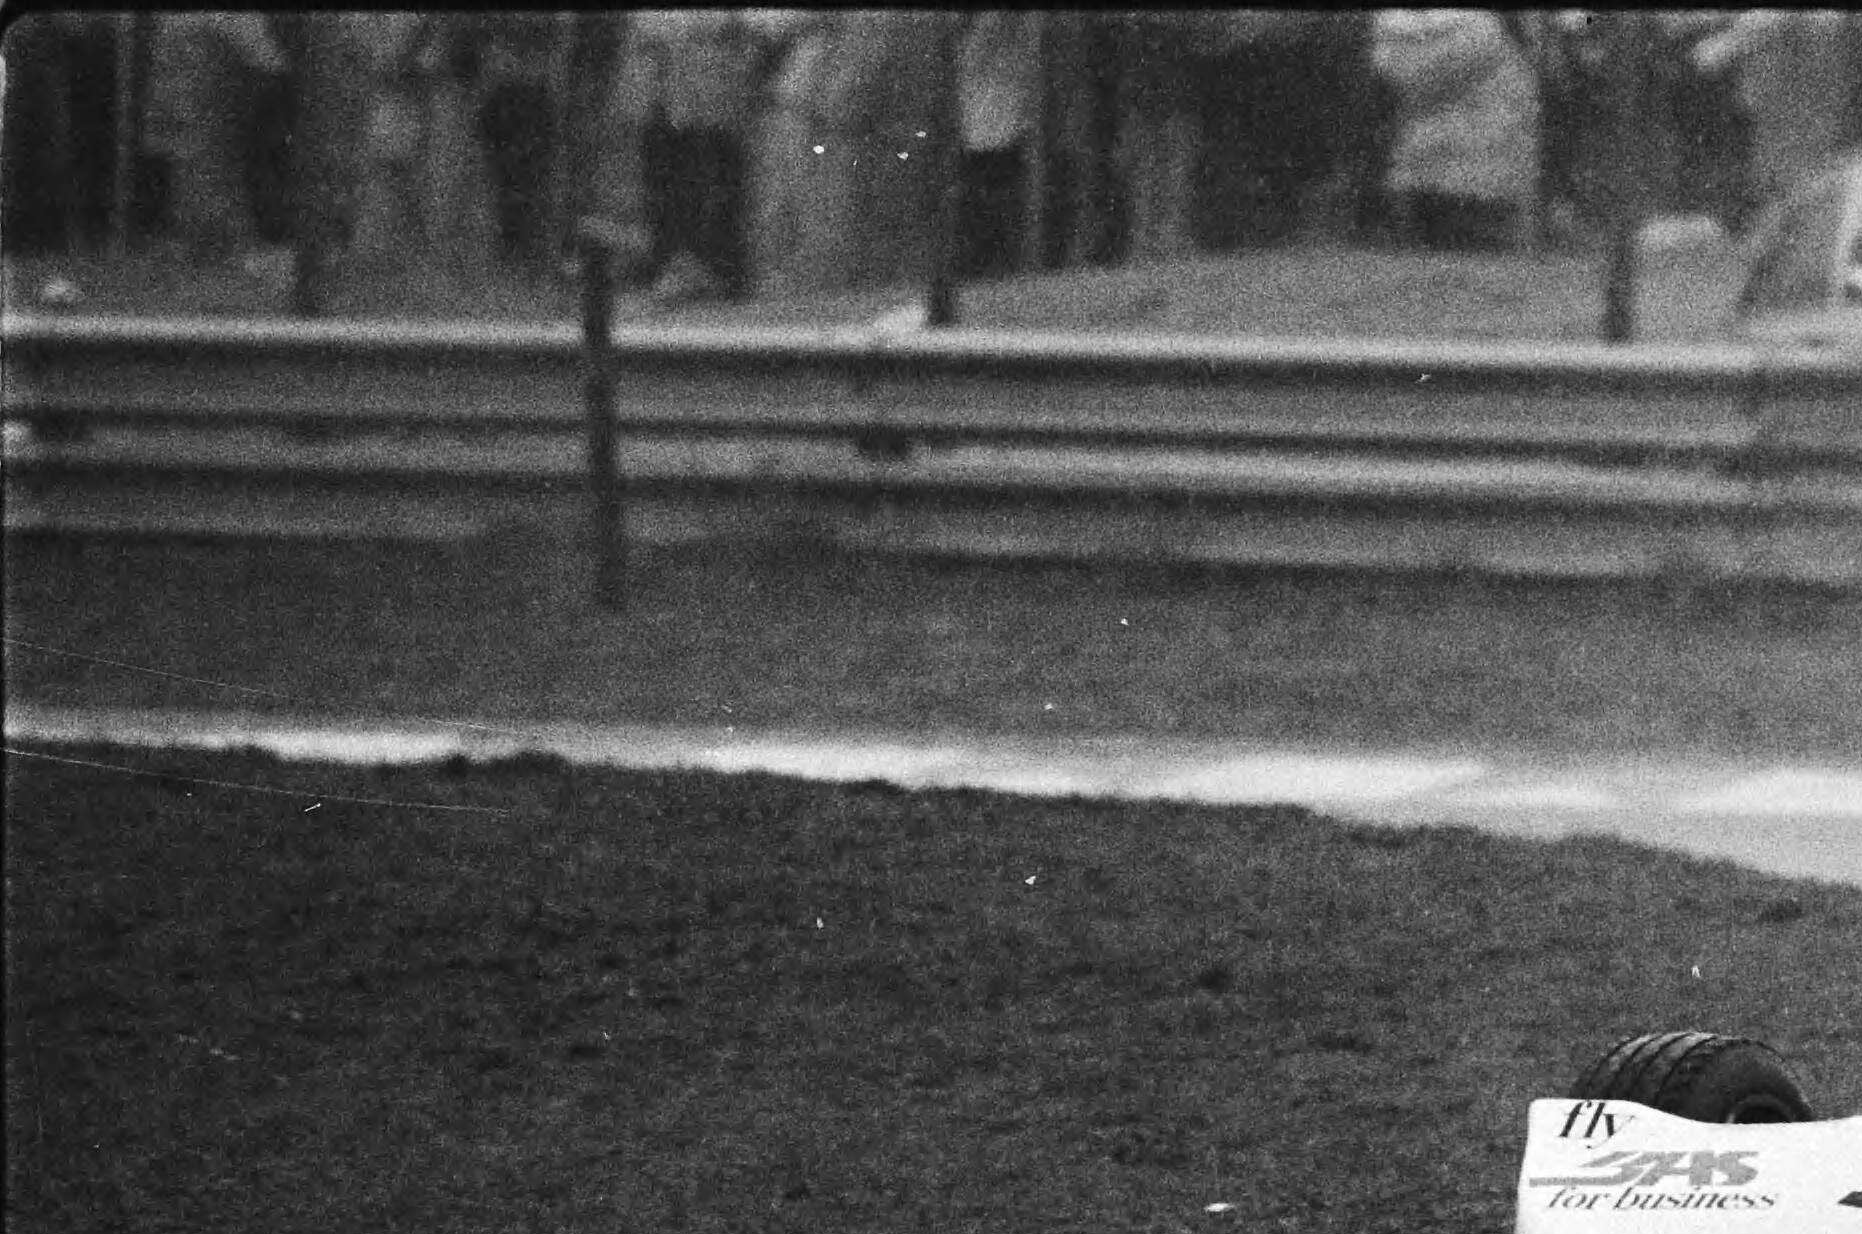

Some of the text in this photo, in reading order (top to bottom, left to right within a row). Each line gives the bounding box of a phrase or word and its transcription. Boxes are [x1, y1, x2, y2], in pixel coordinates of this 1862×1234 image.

[1558, 1100, 1637, 1149] fly
[1547, 1186, 1779, 1210] for business
